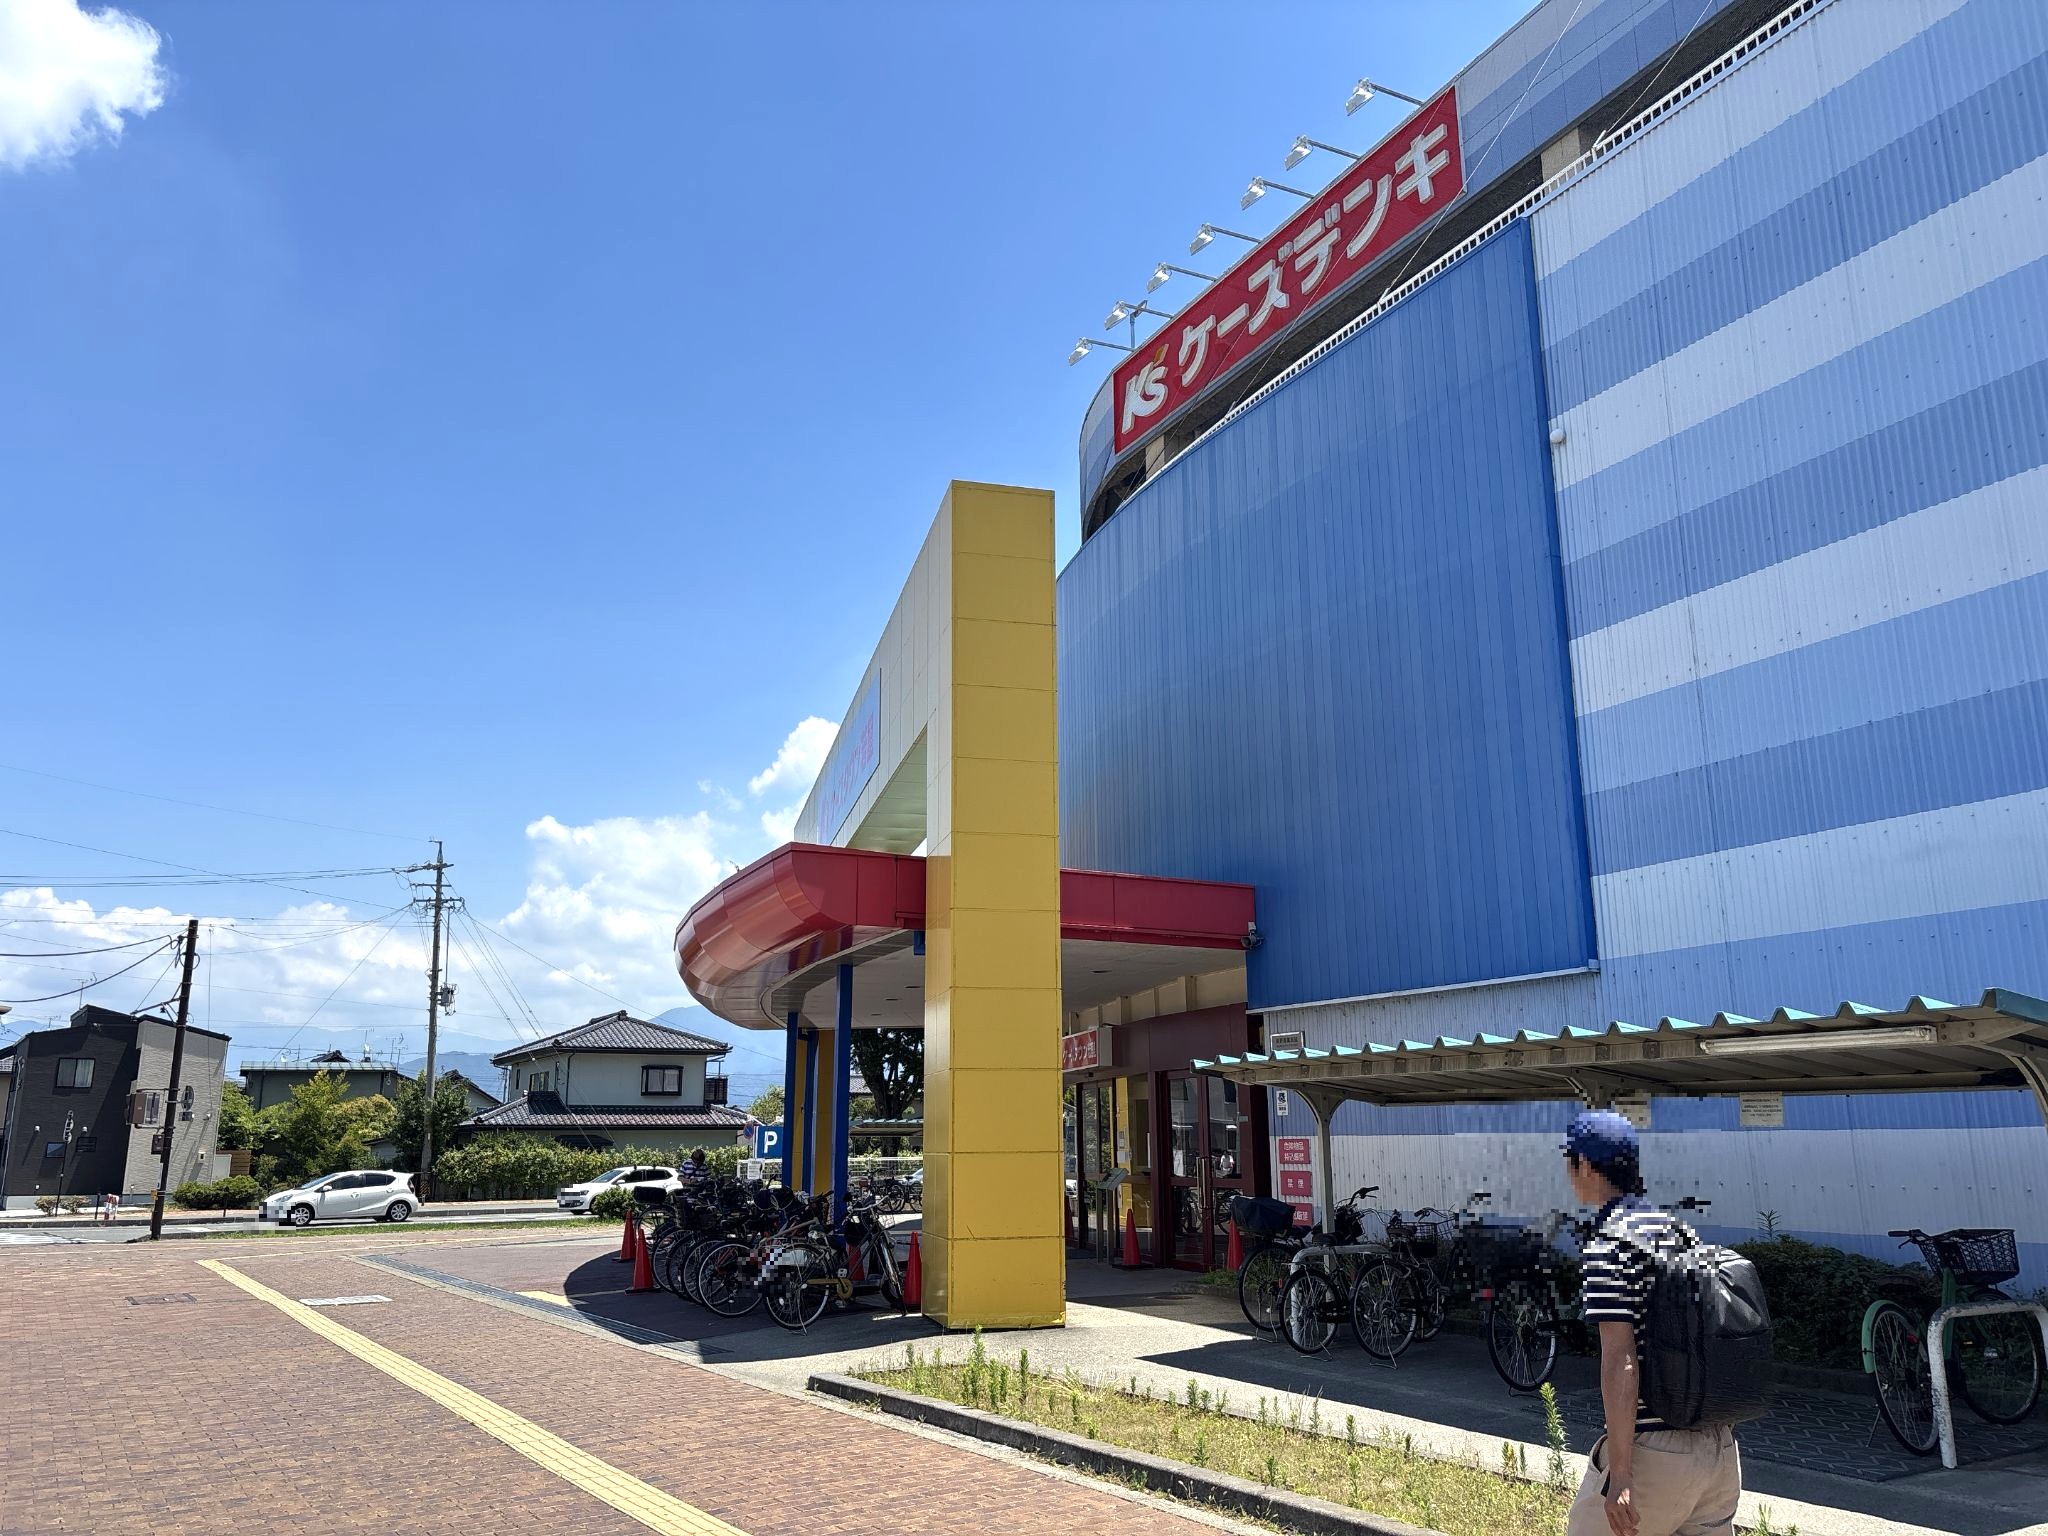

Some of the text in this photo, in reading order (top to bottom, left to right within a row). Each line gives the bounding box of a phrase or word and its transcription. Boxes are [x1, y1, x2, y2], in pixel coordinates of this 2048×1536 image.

[1178, 123, 1450, 387] ケーズデンキ
[764, 1131, 778, 1153] P
